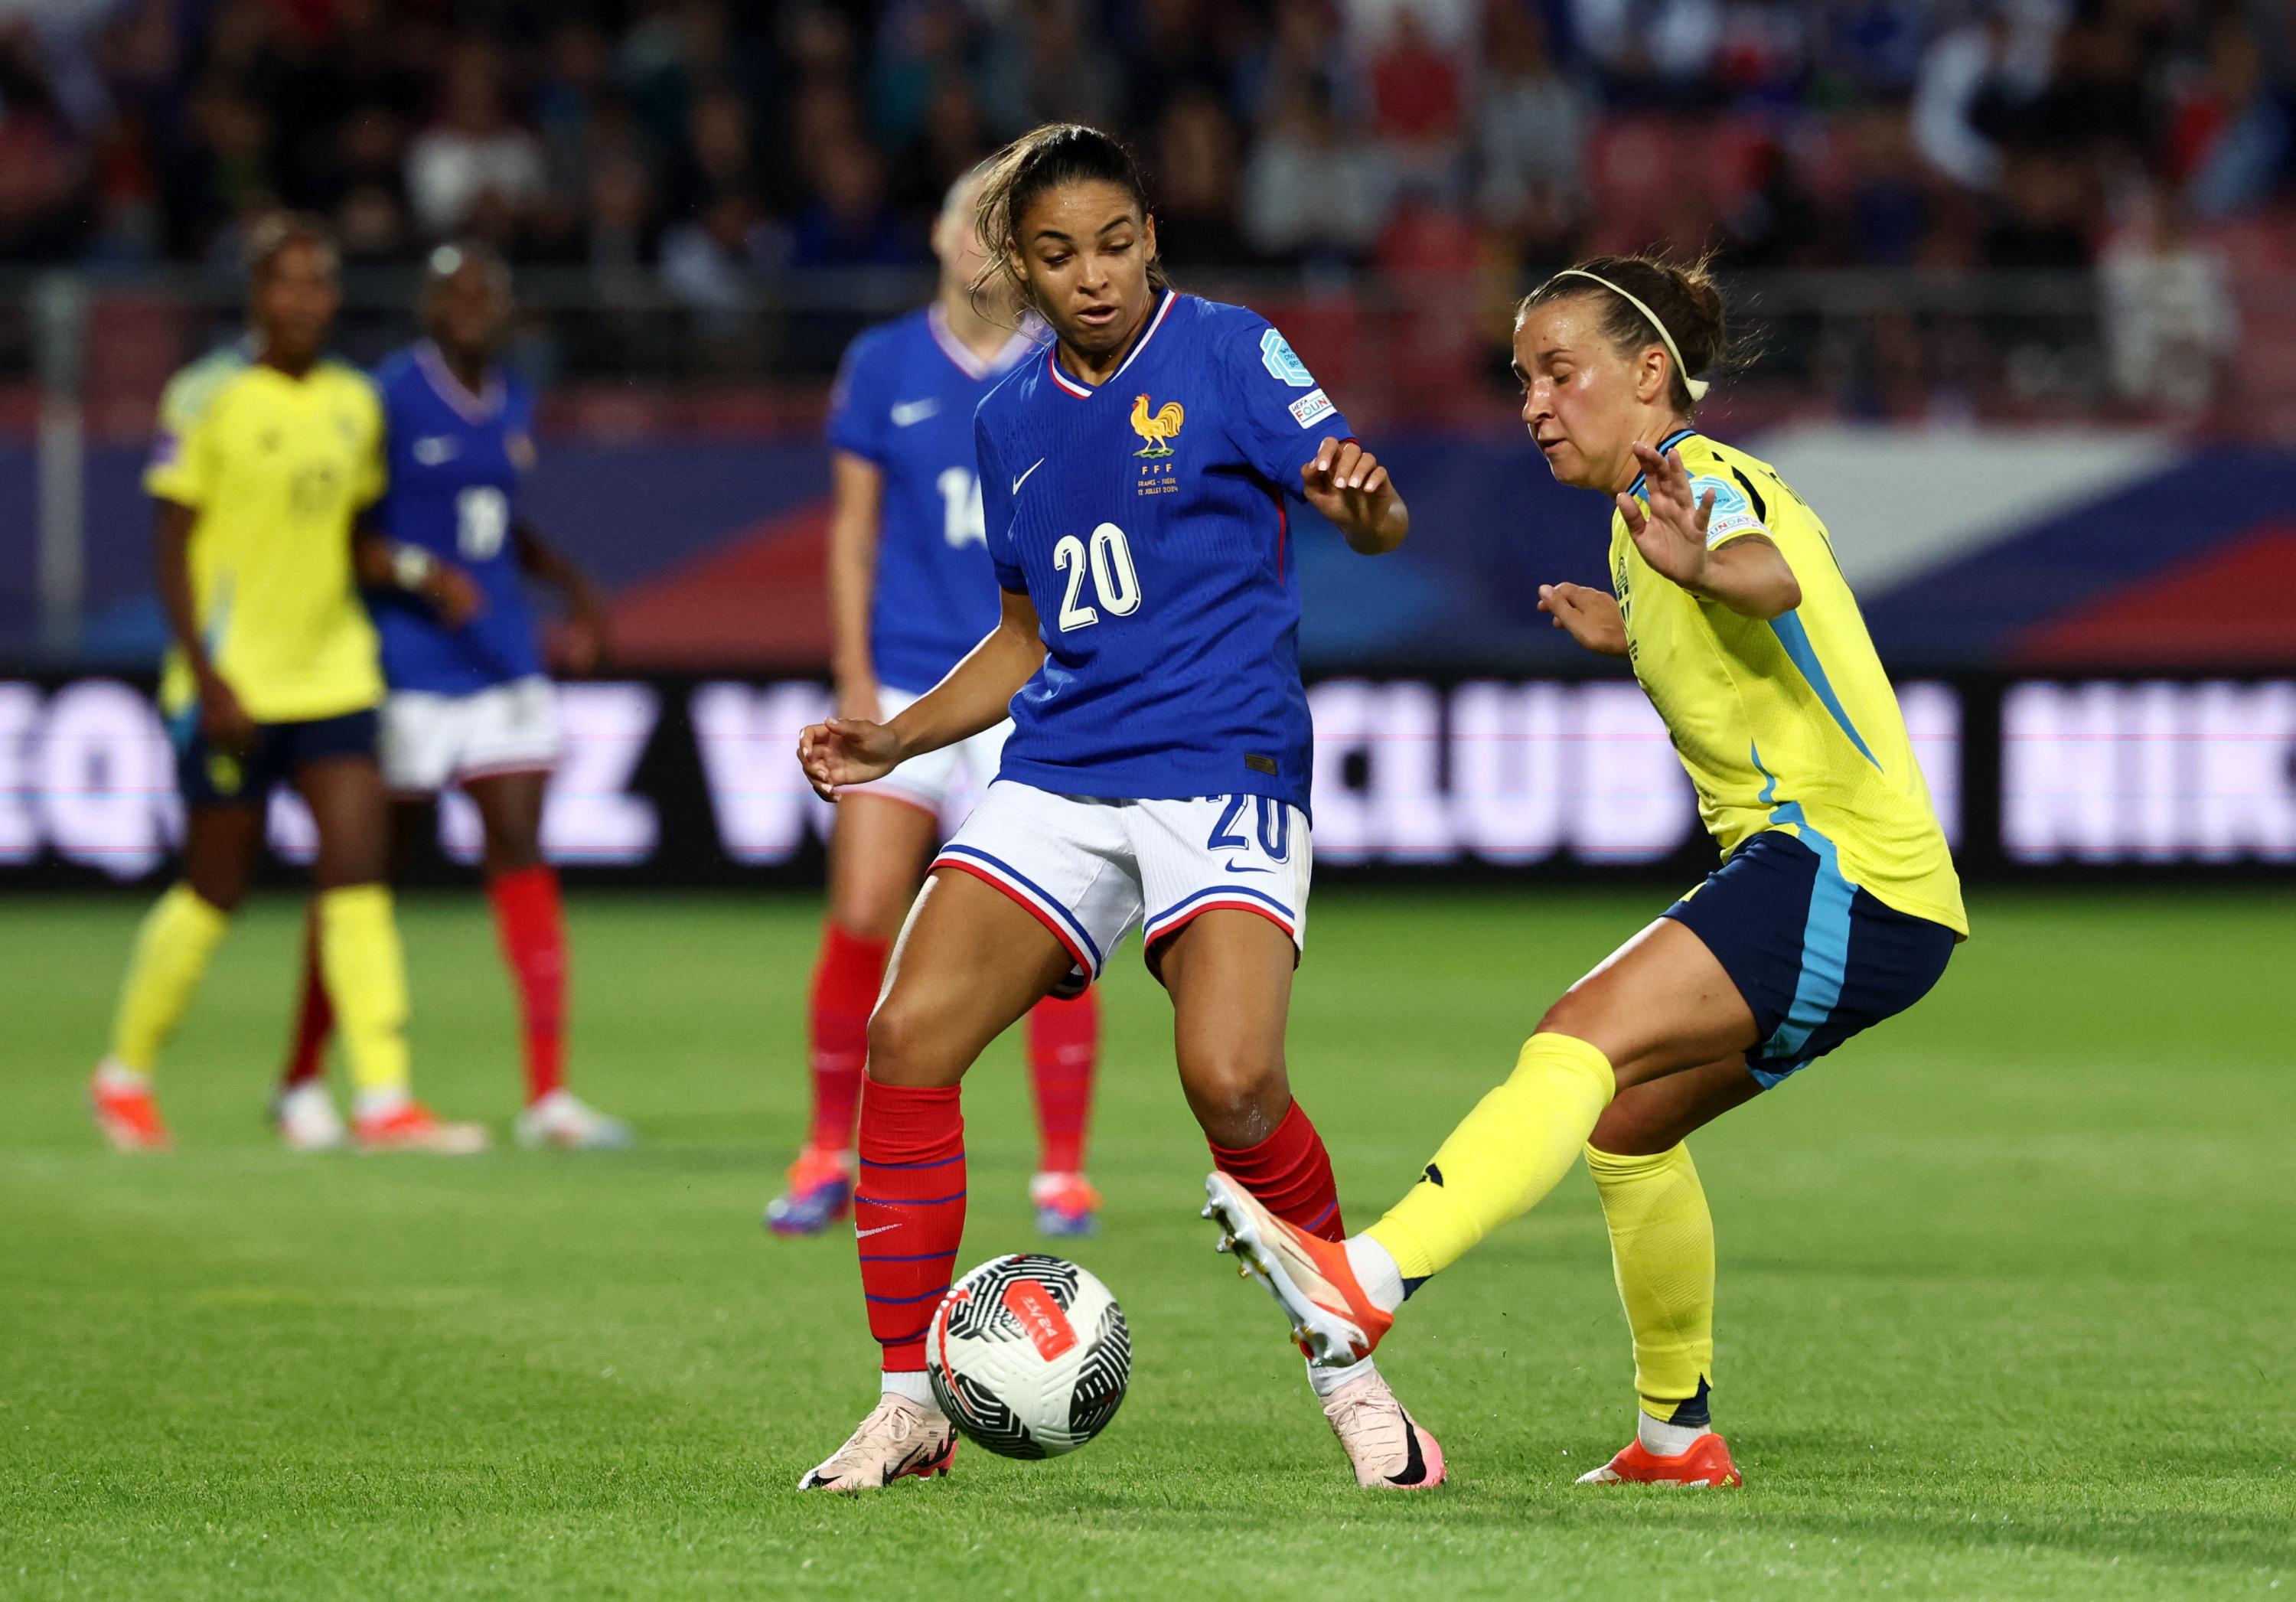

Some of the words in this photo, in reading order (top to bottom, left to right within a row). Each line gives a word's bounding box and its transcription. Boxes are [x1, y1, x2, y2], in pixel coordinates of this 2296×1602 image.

[1291, 400, 1308, 412] UEFA
[1138, 479, 1156, 488] FRANCE
[1053, 522, 1142, 633] 20
[1205, 794, 1290, 865] 20
